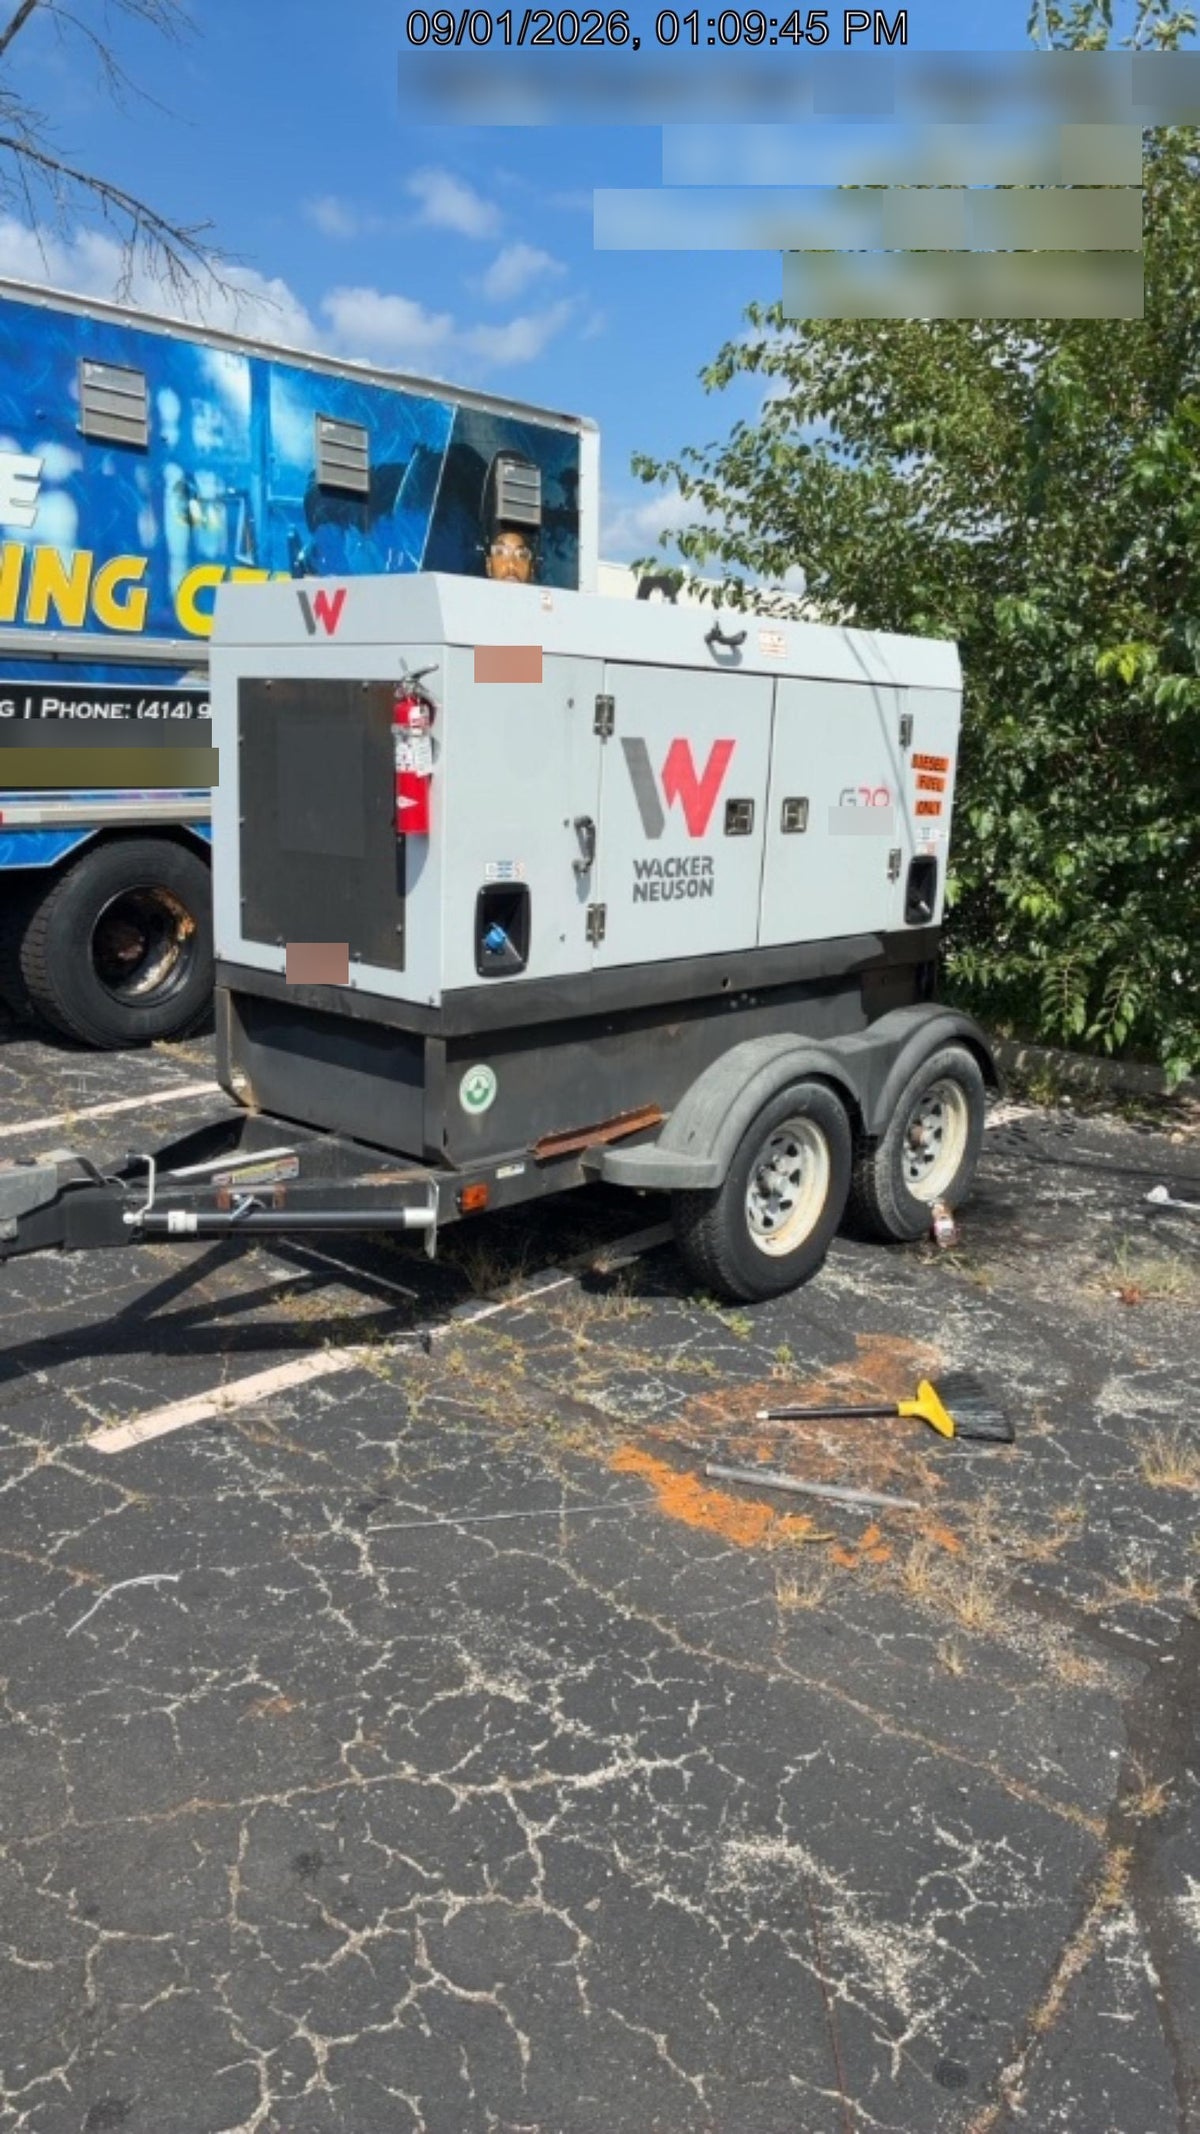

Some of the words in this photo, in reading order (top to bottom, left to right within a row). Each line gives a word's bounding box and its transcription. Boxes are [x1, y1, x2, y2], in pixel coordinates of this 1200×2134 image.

[136, 698, 193, 719] (414)
[917, 775, 944, 792] FUEL
[916, 800, 941, 815] ONLY
[633, 856, 714, 880] WACKER
[633, 878, 714, 903] NEUSON
